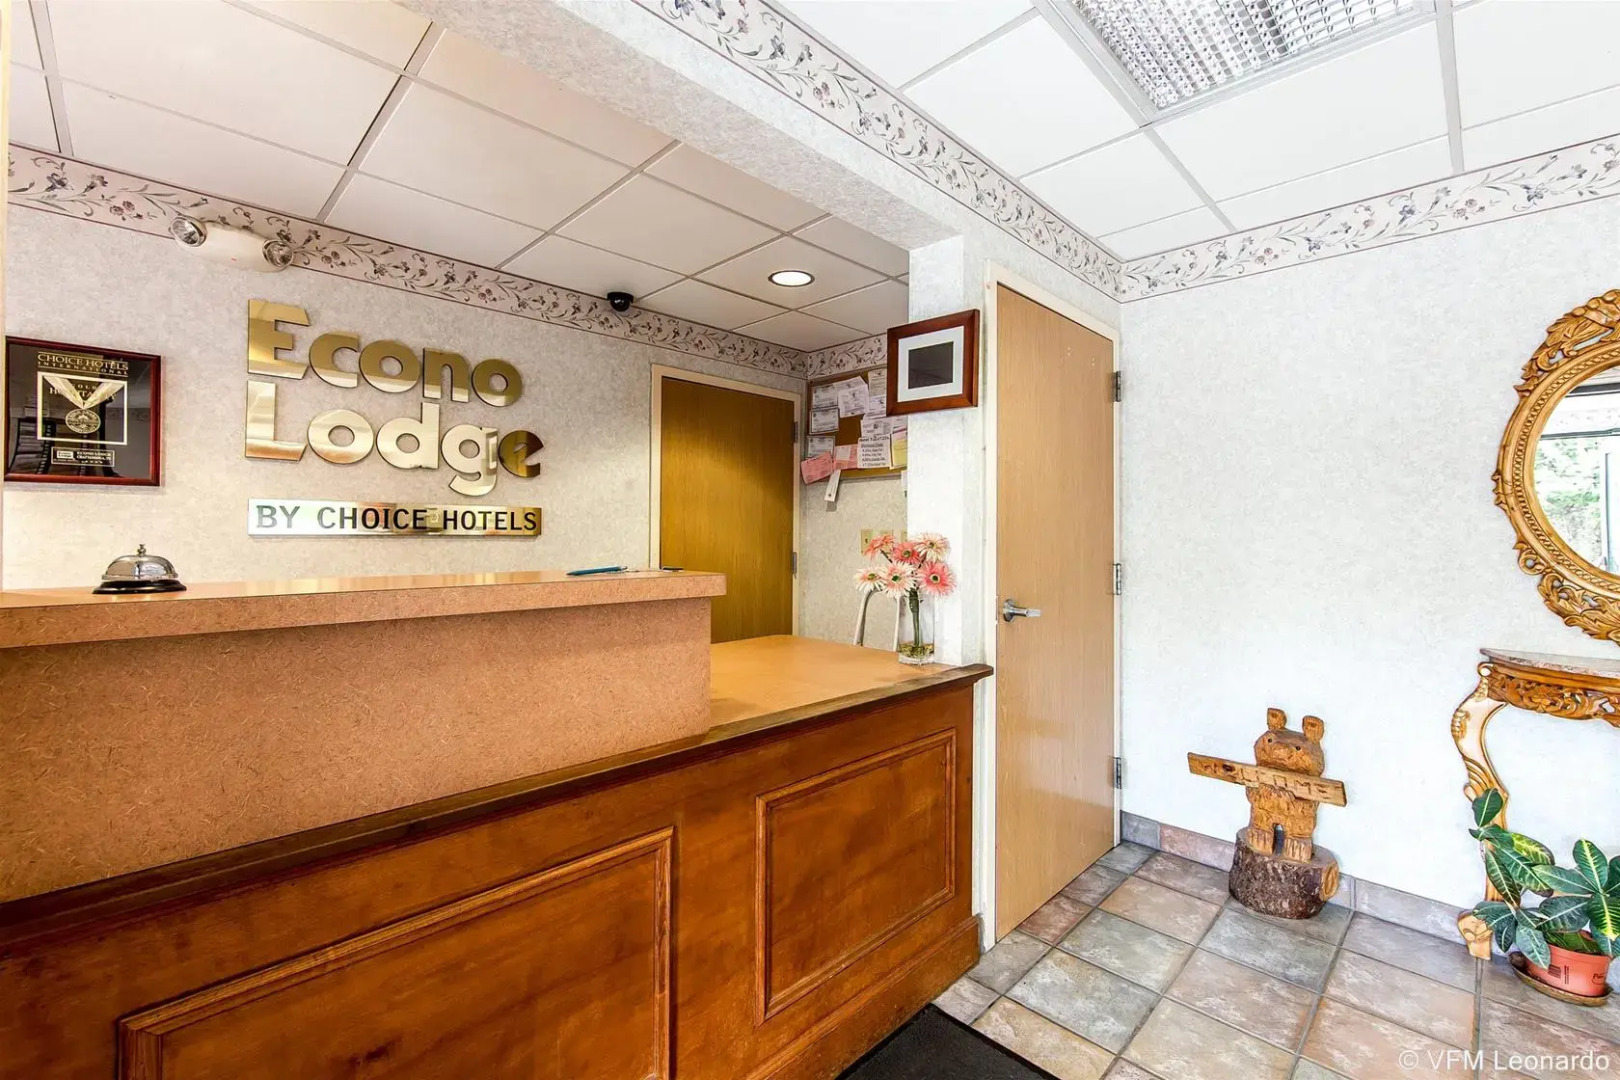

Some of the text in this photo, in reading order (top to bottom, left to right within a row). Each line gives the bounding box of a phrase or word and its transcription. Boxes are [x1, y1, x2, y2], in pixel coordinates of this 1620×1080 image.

[37, 353, 129, 371] CHOICE HOTELS
[247, 299, 523, 408] Econo
[38, 361, 128, 375] INTERNATIONAL
[245, 380, 544, 497] Lodge
[256, 505, 537, 531] BY CHOICE HOTELS
